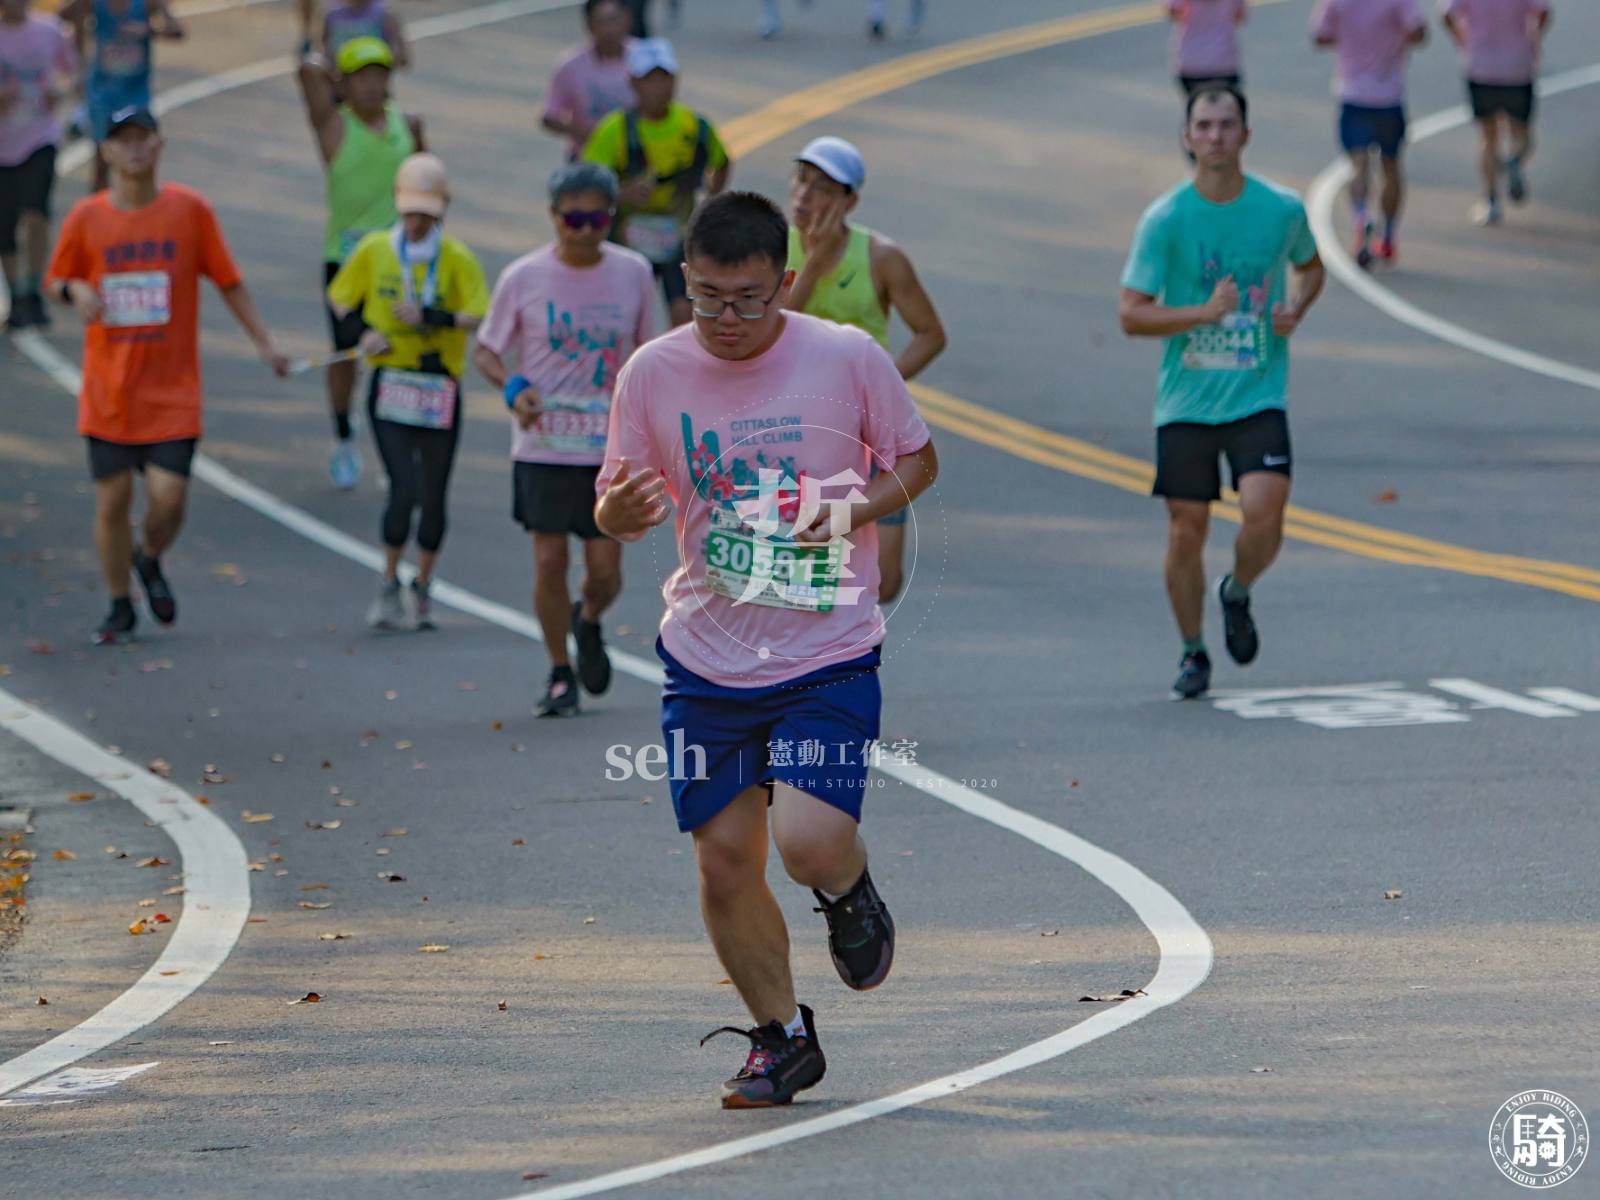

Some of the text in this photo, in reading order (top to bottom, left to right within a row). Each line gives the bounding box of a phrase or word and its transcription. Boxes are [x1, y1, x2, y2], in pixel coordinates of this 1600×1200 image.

[730, 416, 802, 431] CITTASLOW
[731, 431, 803, 446] HILL CLIMB
